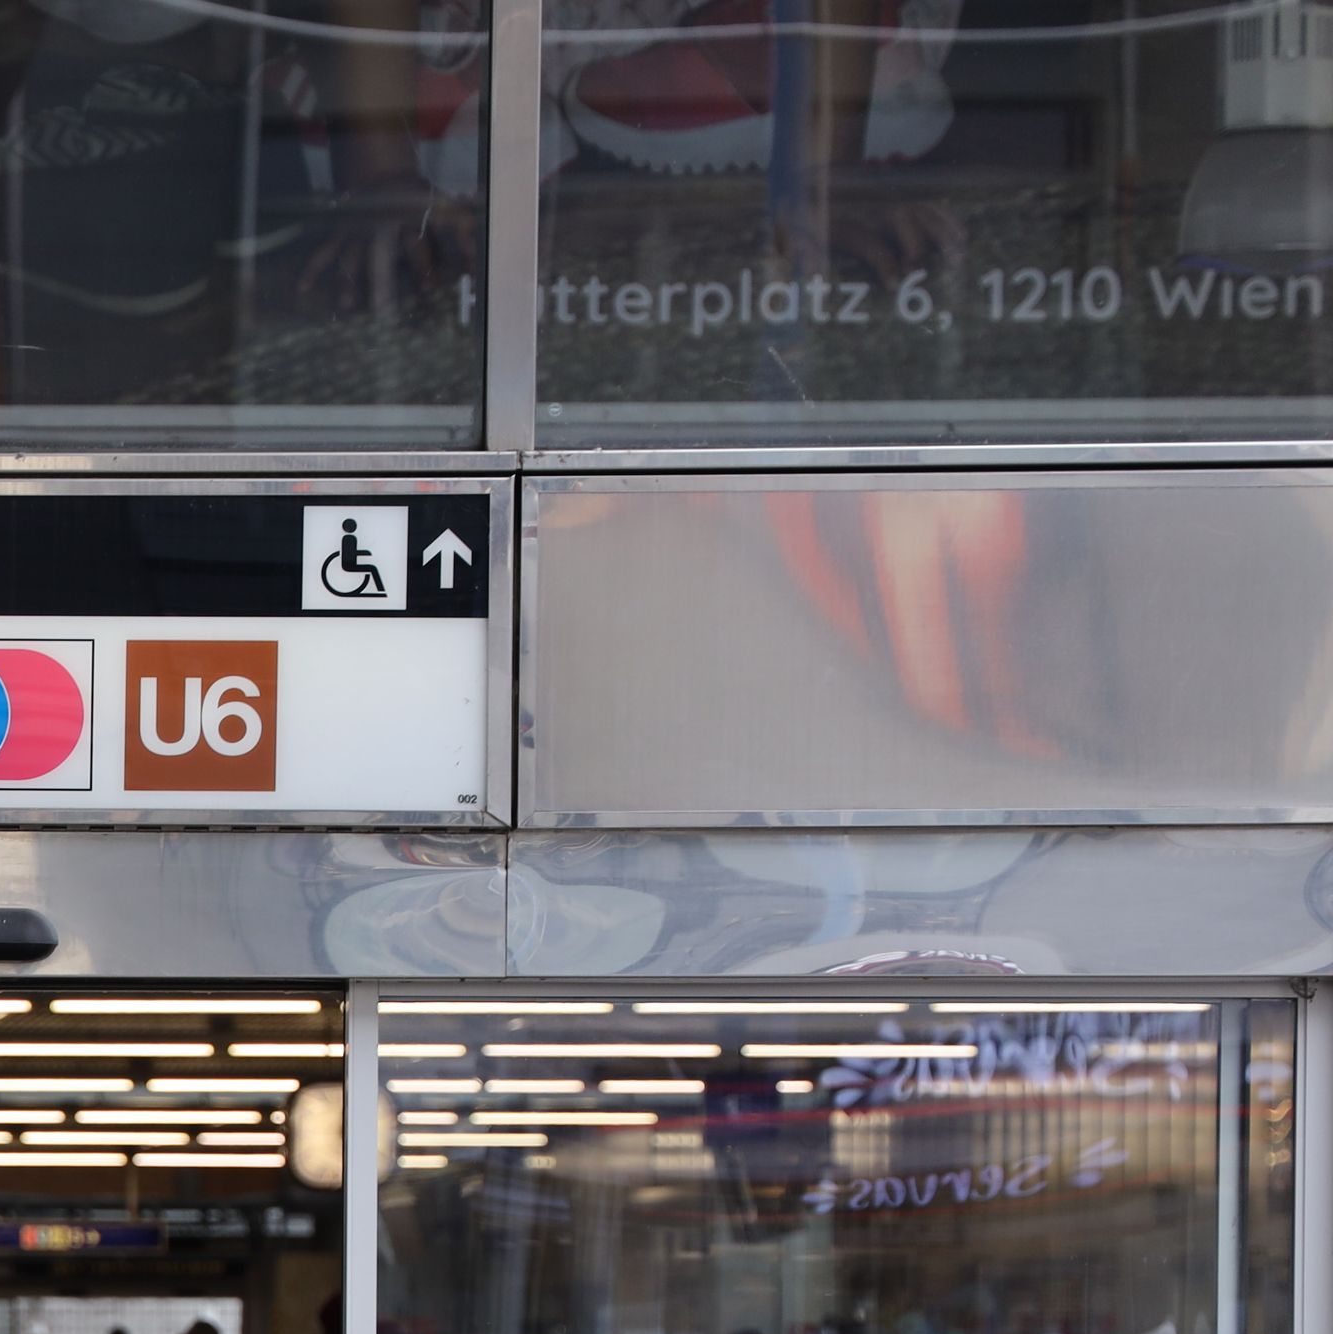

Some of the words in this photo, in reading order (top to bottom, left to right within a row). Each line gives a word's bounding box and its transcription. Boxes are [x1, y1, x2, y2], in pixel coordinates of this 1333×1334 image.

[897, 268, 955, 333] 6,
[980, 266, 1121, 323] 1210
[1150, 268, 1321, 322] Wien
[139, 675, 264, 757] U6
[457, 794, 478, 805] 002
